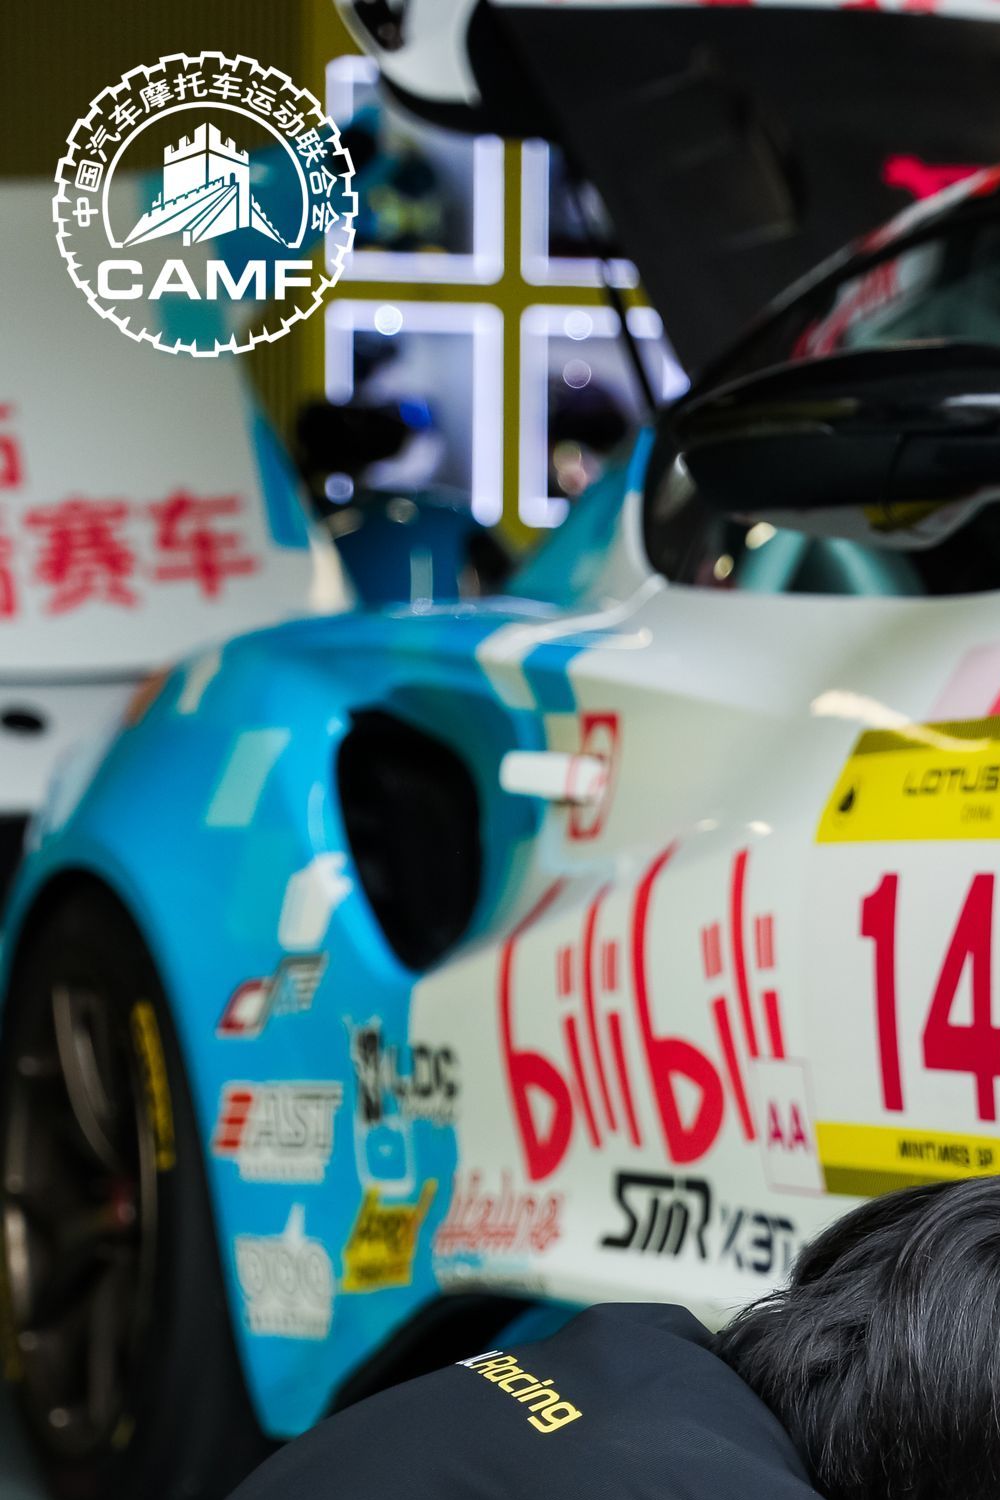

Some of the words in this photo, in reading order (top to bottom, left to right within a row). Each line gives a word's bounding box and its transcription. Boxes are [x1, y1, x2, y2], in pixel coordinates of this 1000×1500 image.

[0, 487, 263, 620] 赛车
[903, 766, 1000, 797] LOTUS
[498, 840, 785, 1181] bilibili
[767, 1100, 811, 1152] AA
